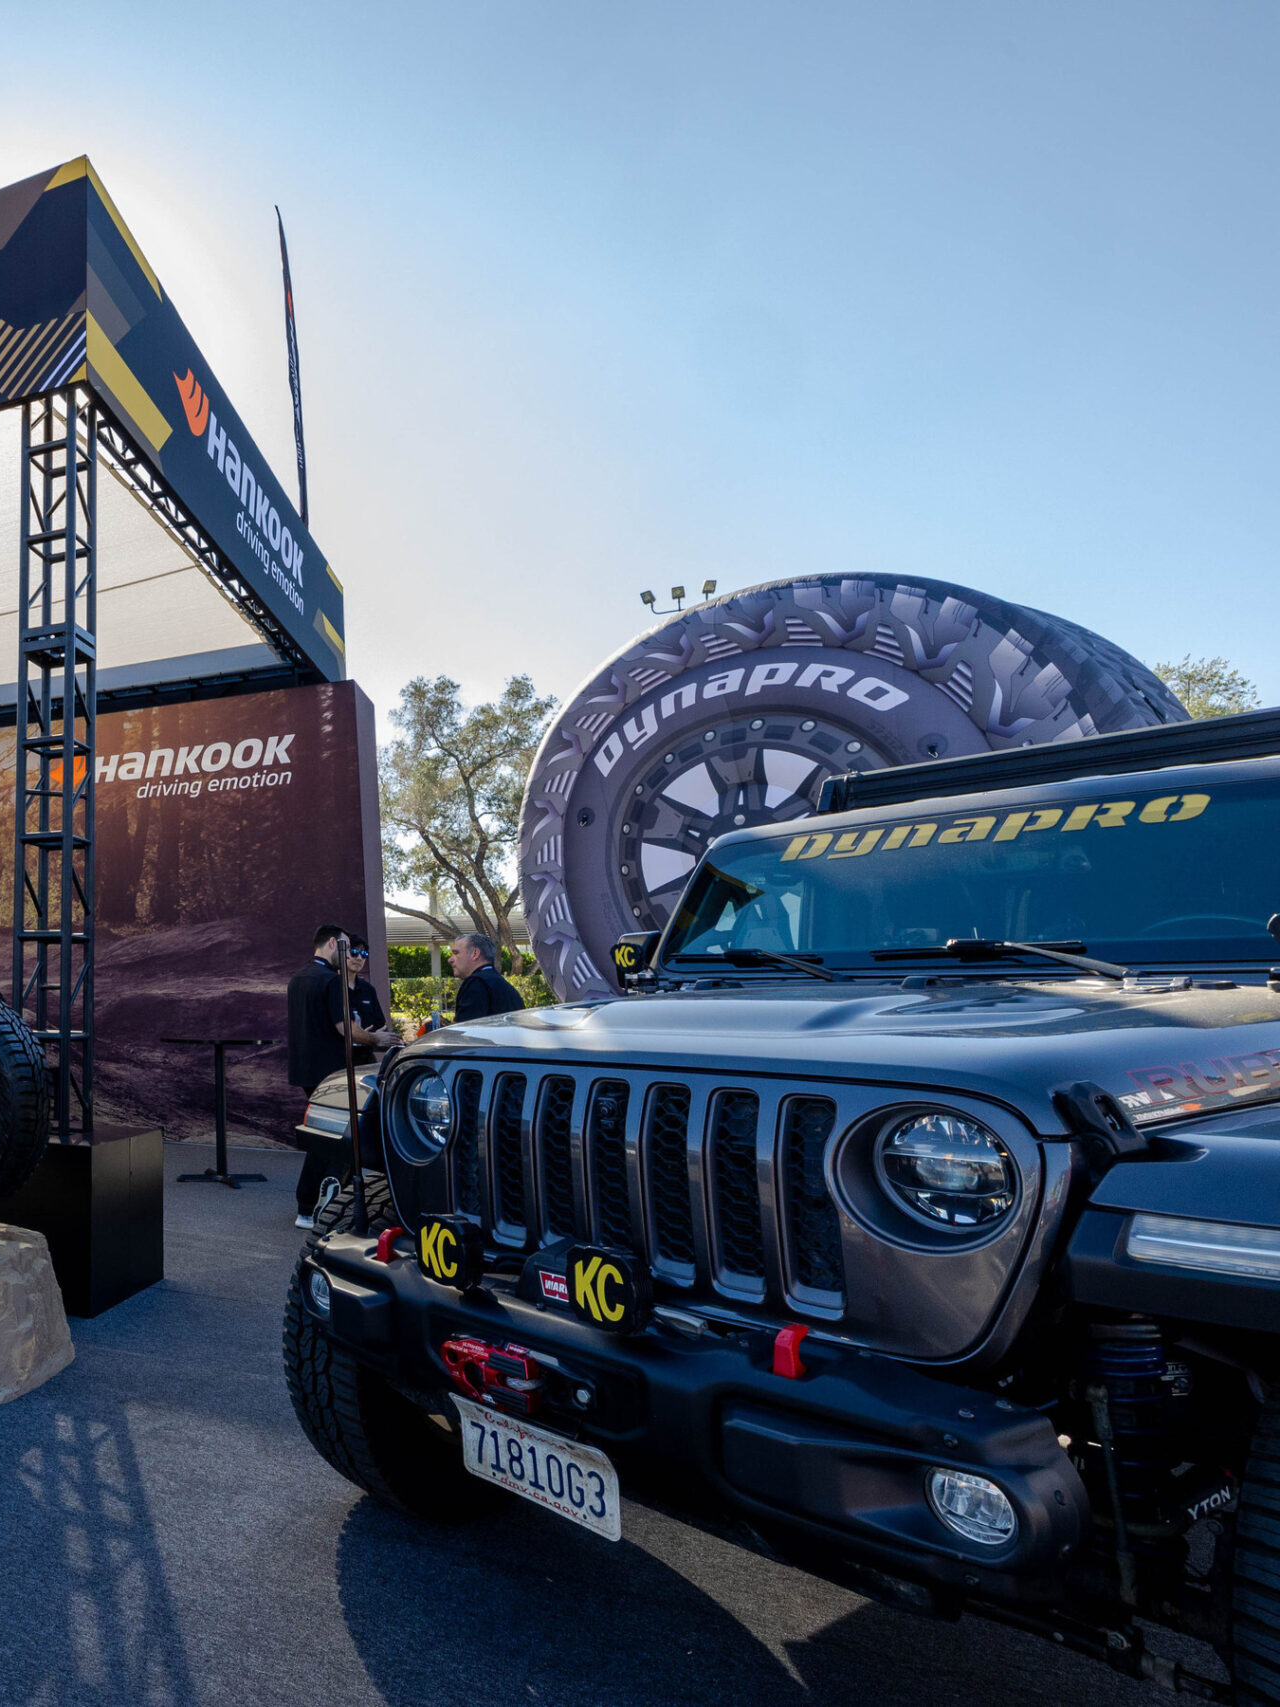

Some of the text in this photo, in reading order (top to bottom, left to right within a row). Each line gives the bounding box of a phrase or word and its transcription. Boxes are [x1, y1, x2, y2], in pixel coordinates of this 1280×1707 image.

[236, 511, 304, 616] driving emotion
[136, 770, 293, 799] driving emotion
[614, 945, 636, 968] KC
[421, 1222, 458, 1279] KC
[574, 1256, 625, 1322] KC
[484, 1411, 568, 1451] California
[470, 1421, 606, 1518] 71810G3
[500, 1476, 579, 1517] dmv.ca.gov
[1187, 1486, 1232, 1520] YTON
